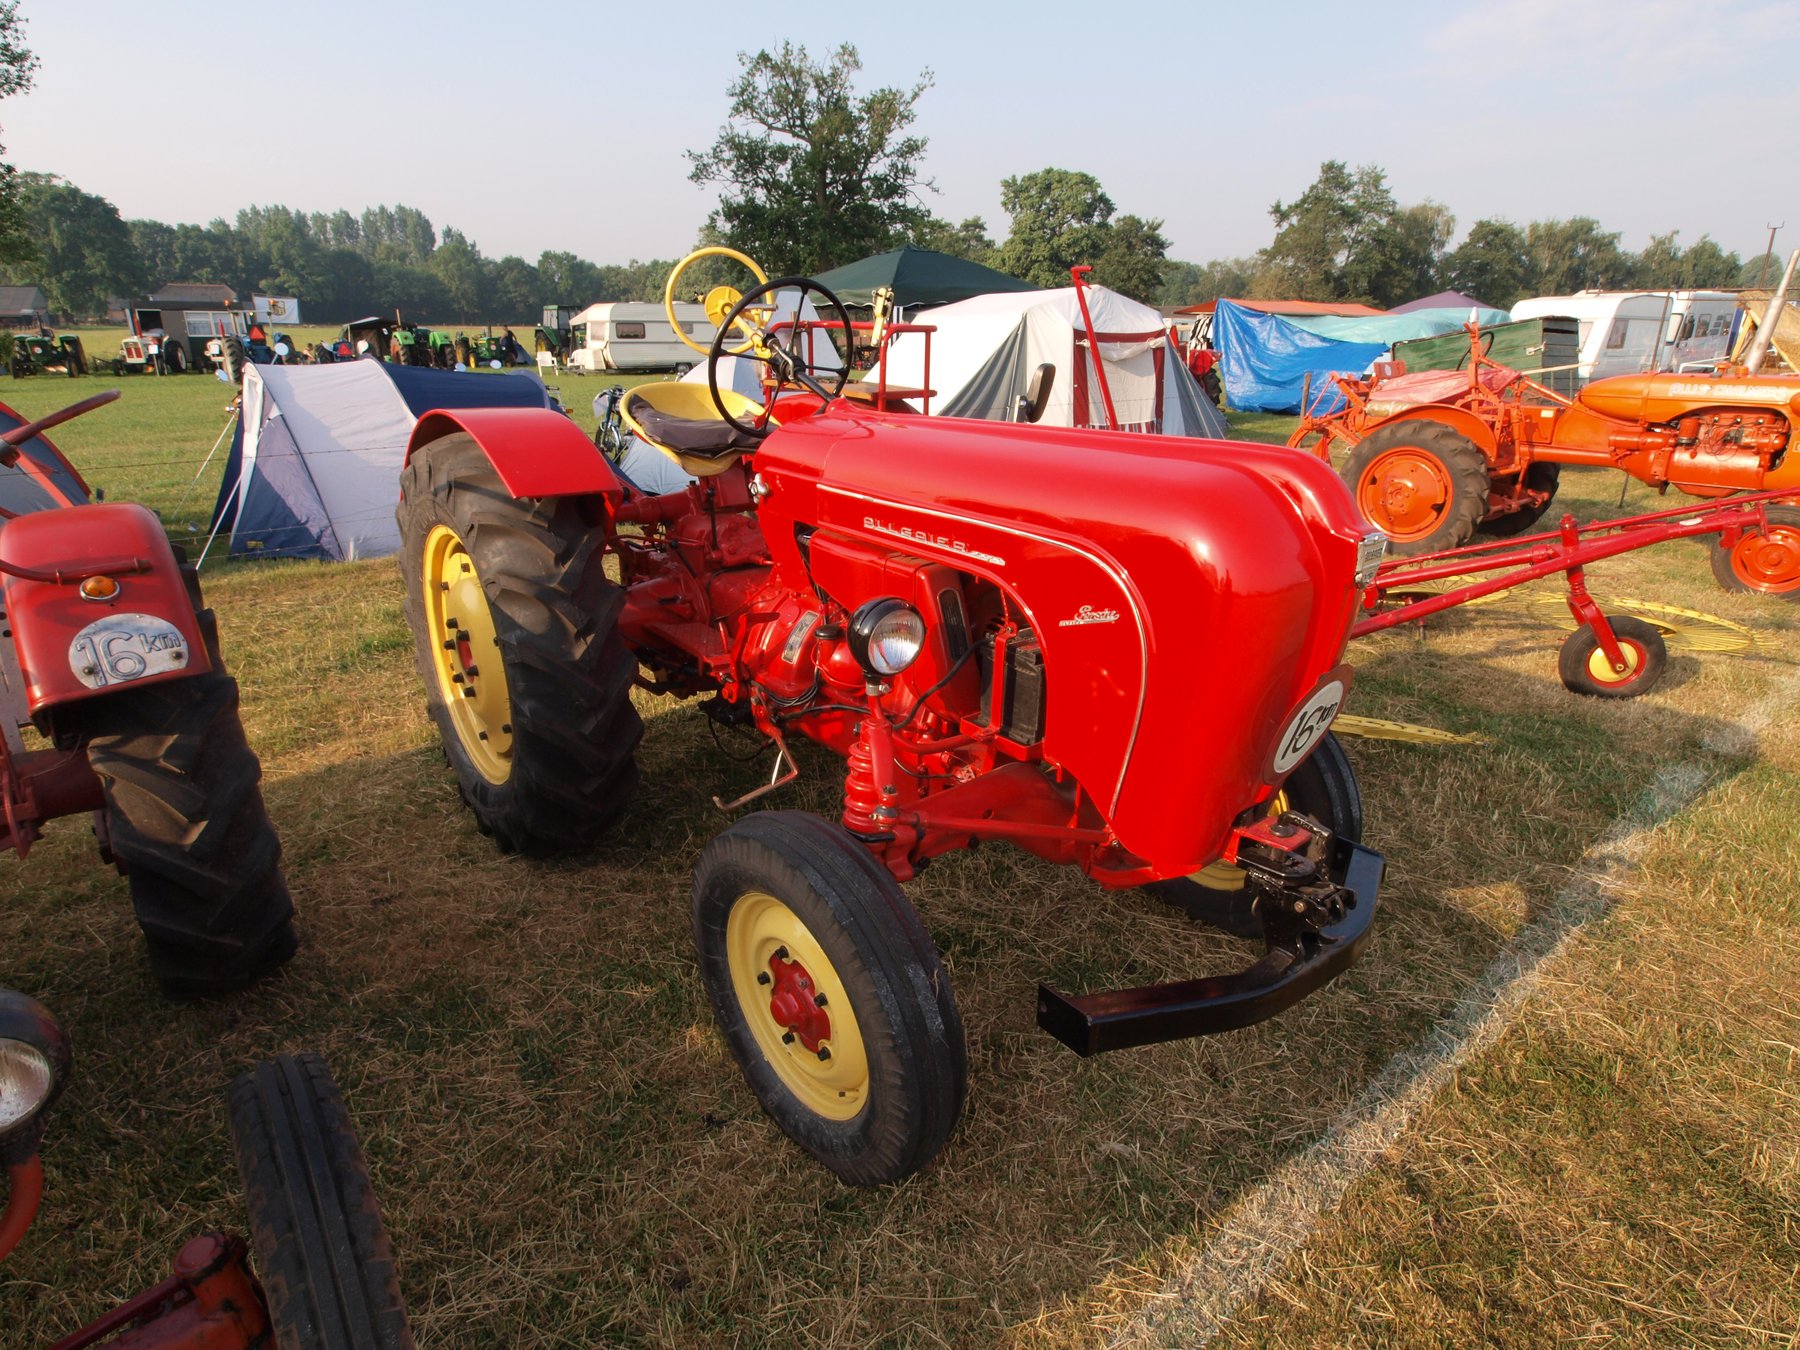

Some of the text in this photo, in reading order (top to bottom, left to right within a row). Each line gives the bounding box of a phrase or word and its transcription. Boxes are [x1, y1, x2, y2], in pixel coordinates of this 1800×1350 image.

[863, 516, 969, 553] ALLGAIER
[76, 630, 147, 687] 16
[1281, 705, 1325, 760] 16
